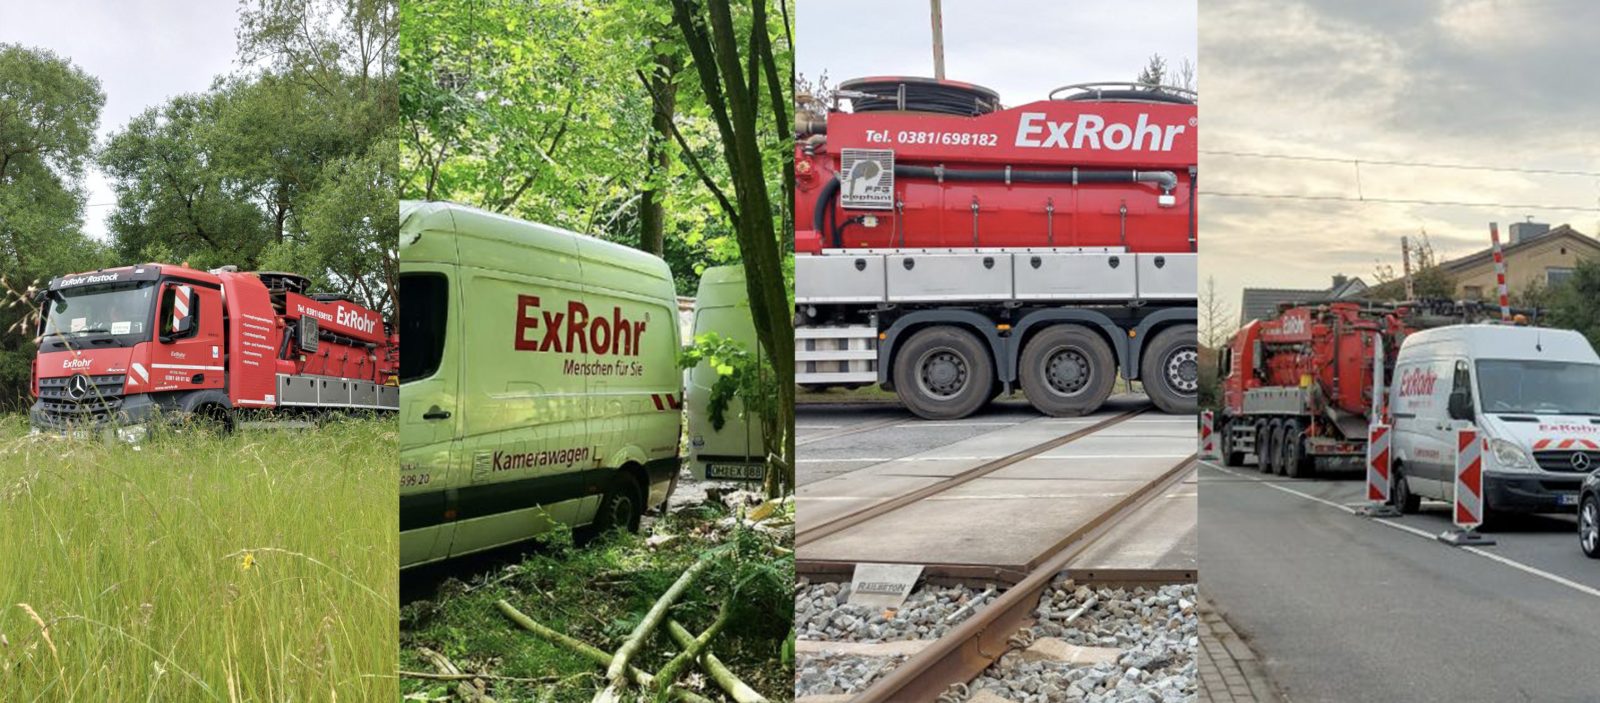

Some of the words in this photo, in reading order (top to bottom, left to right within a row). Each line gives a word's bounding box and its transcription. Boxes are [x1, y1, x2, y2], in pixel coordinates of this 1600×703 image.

[866, 130, 892, 143] Tel.
[897, 131, 998, 146] 0381/698182
[1015, 112, 1185, 151] ExRohr
[87, 273, 119, 283] Rostock
[336, 305, 376, 334] ExRohr
[514, 294, 646, 357] ExRohr
[62, 358, 92, 369] ExRohr
[563, 359, 613, 376] Menschen
[615, 359, 629, 376] für
[630, 361, 643, 376] Sie
[492, 446, 589, 472] Kamerawagen
[418, 473, 430, 485] 20
